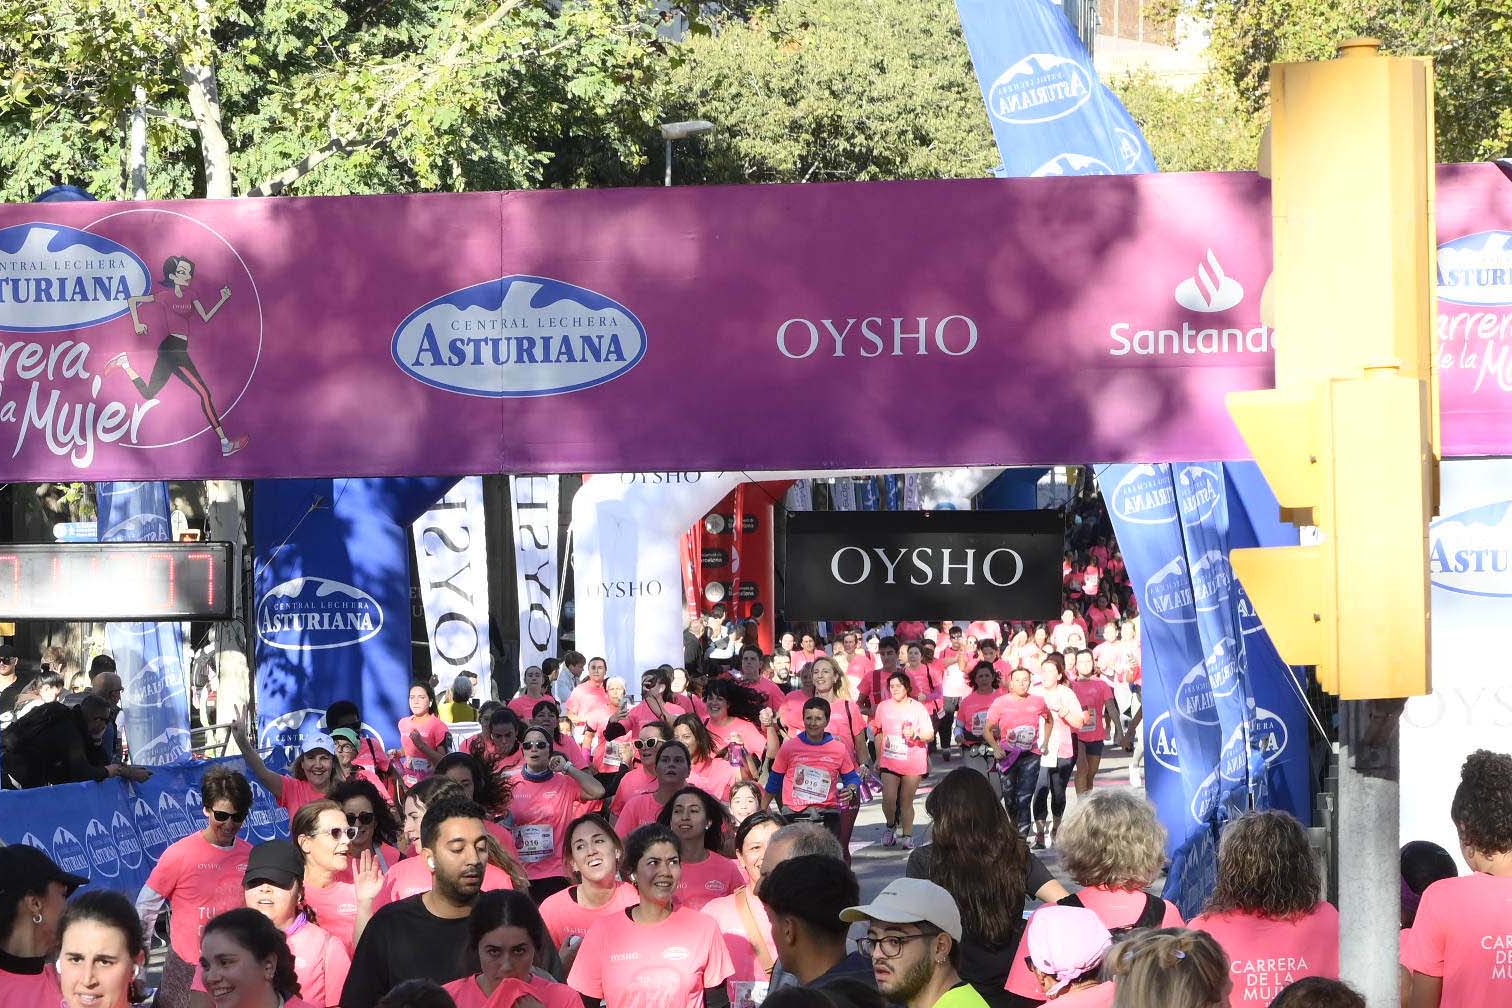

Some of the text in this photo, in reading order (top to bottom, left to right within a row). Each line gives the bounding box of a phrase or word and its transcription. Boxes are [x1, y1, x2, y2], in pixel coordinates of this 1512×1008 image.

[53, 259, 126, 272] LECHERA
[451, 316, 619, 330] CENTRAL LECHERA
[412, 323, 627, 367] ASTURIANA
[777, 314, 978, 359] OYSHO
[1110, 322, 1275, 355] Santand
[831, 546, 1024, 587] OYSHO
[261, 606, 375, 633] ASTURIANA
[1230, 958, 1308, 973] CARRERA
[1247, 971, 1295, 986] DE LA
[1243, 986, 1284, 1001] MUJ
